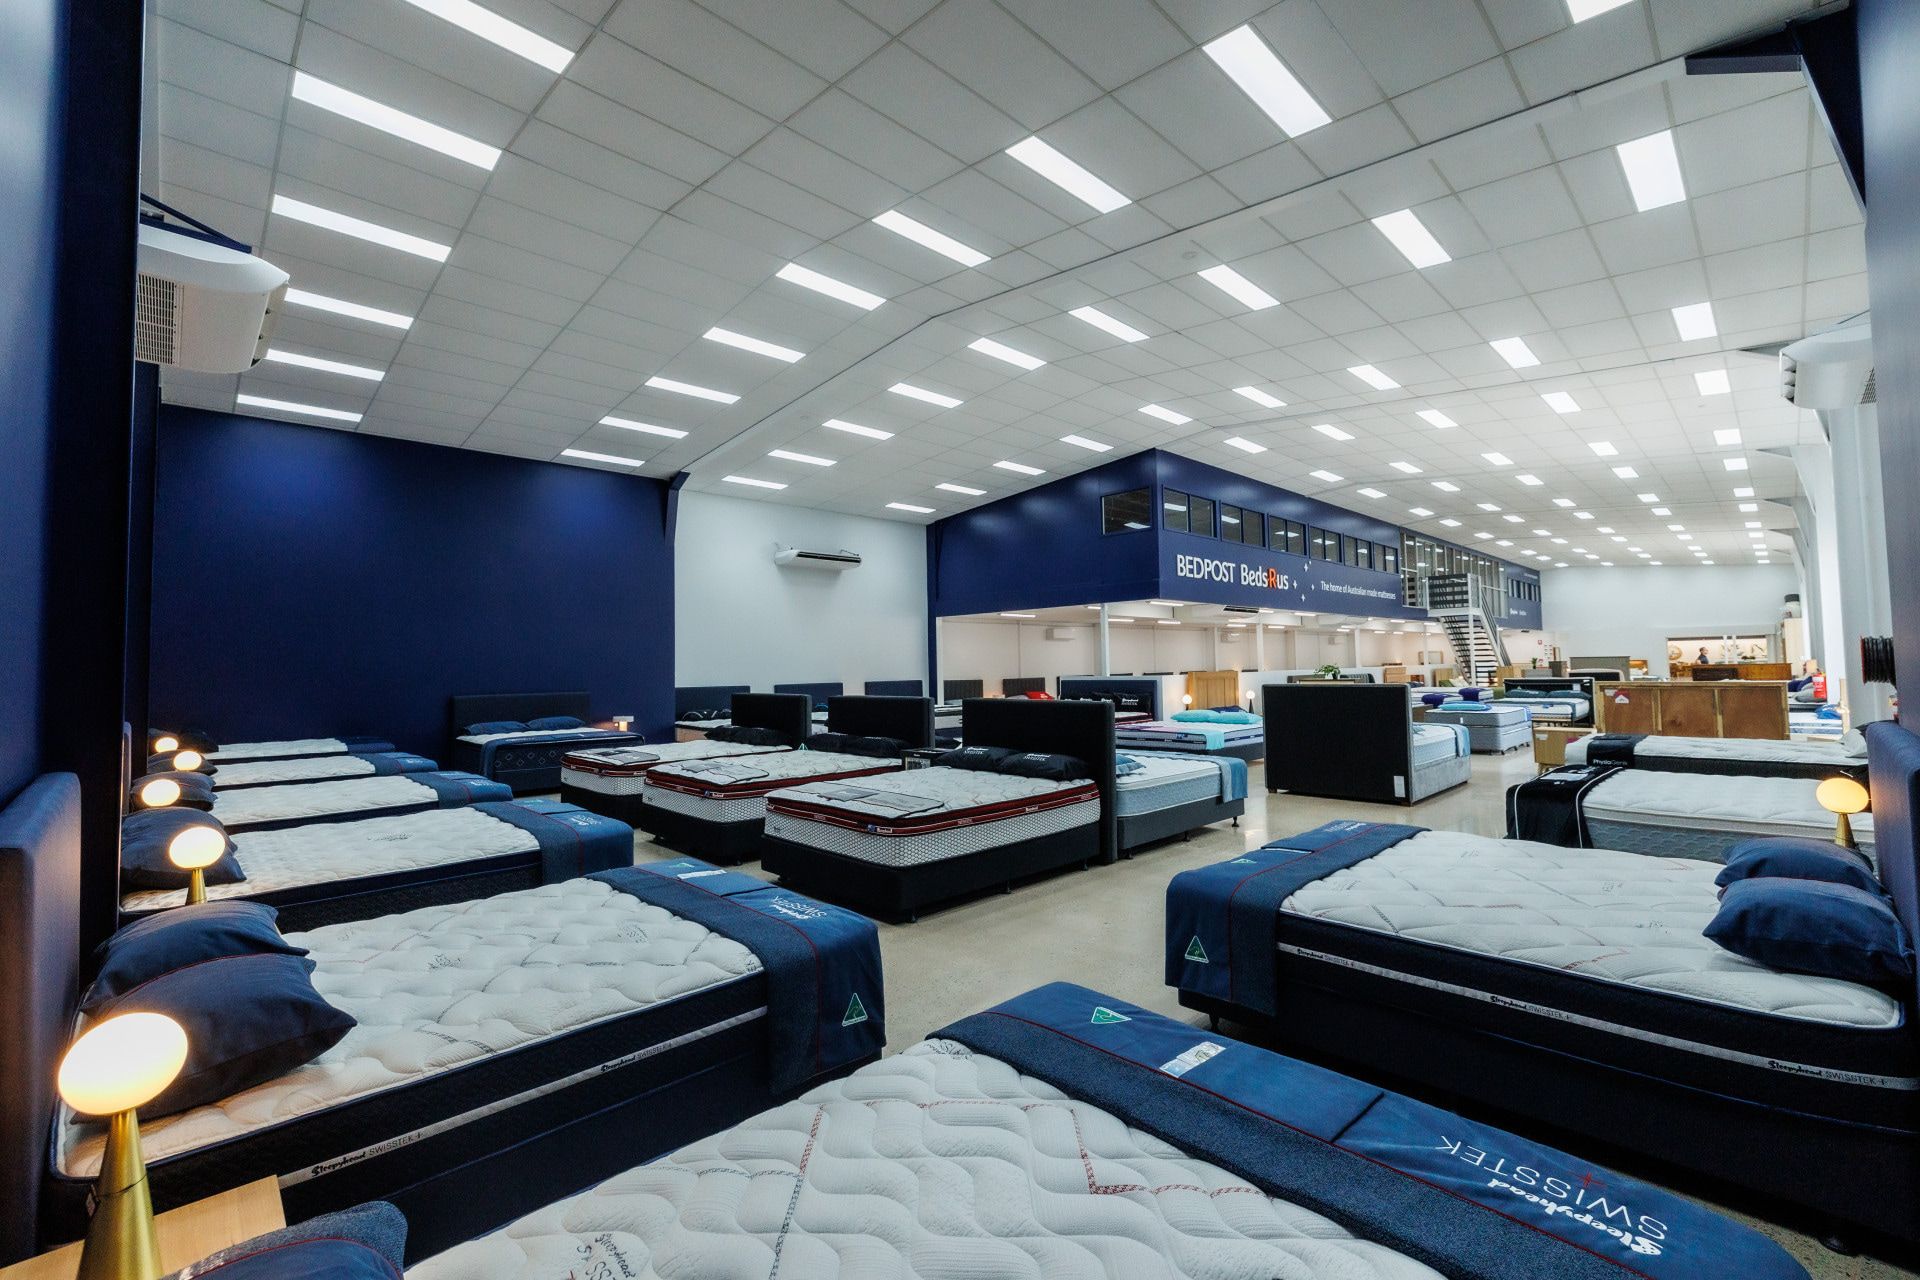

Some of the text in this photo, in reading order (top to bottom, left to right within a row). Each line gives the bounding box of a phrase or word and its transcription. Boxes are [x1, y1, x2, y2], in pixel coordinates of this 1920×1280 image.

[1177, 554, 1235, 583] BEDPOST
[1321, 581, 1329, 591] The
[1330, 582, 1342, 593] home
[1343, 584, 1348, 593] of
[1825, 1071, 1876, 1085] SWISSTEK
[311, 1135, 413, 1177] Sleepyhead SWISSTEK
[1436, 1135, 1668, 1240] SWISSTEK
[1487, 1178, 1664, 1256] Sleepyhead
